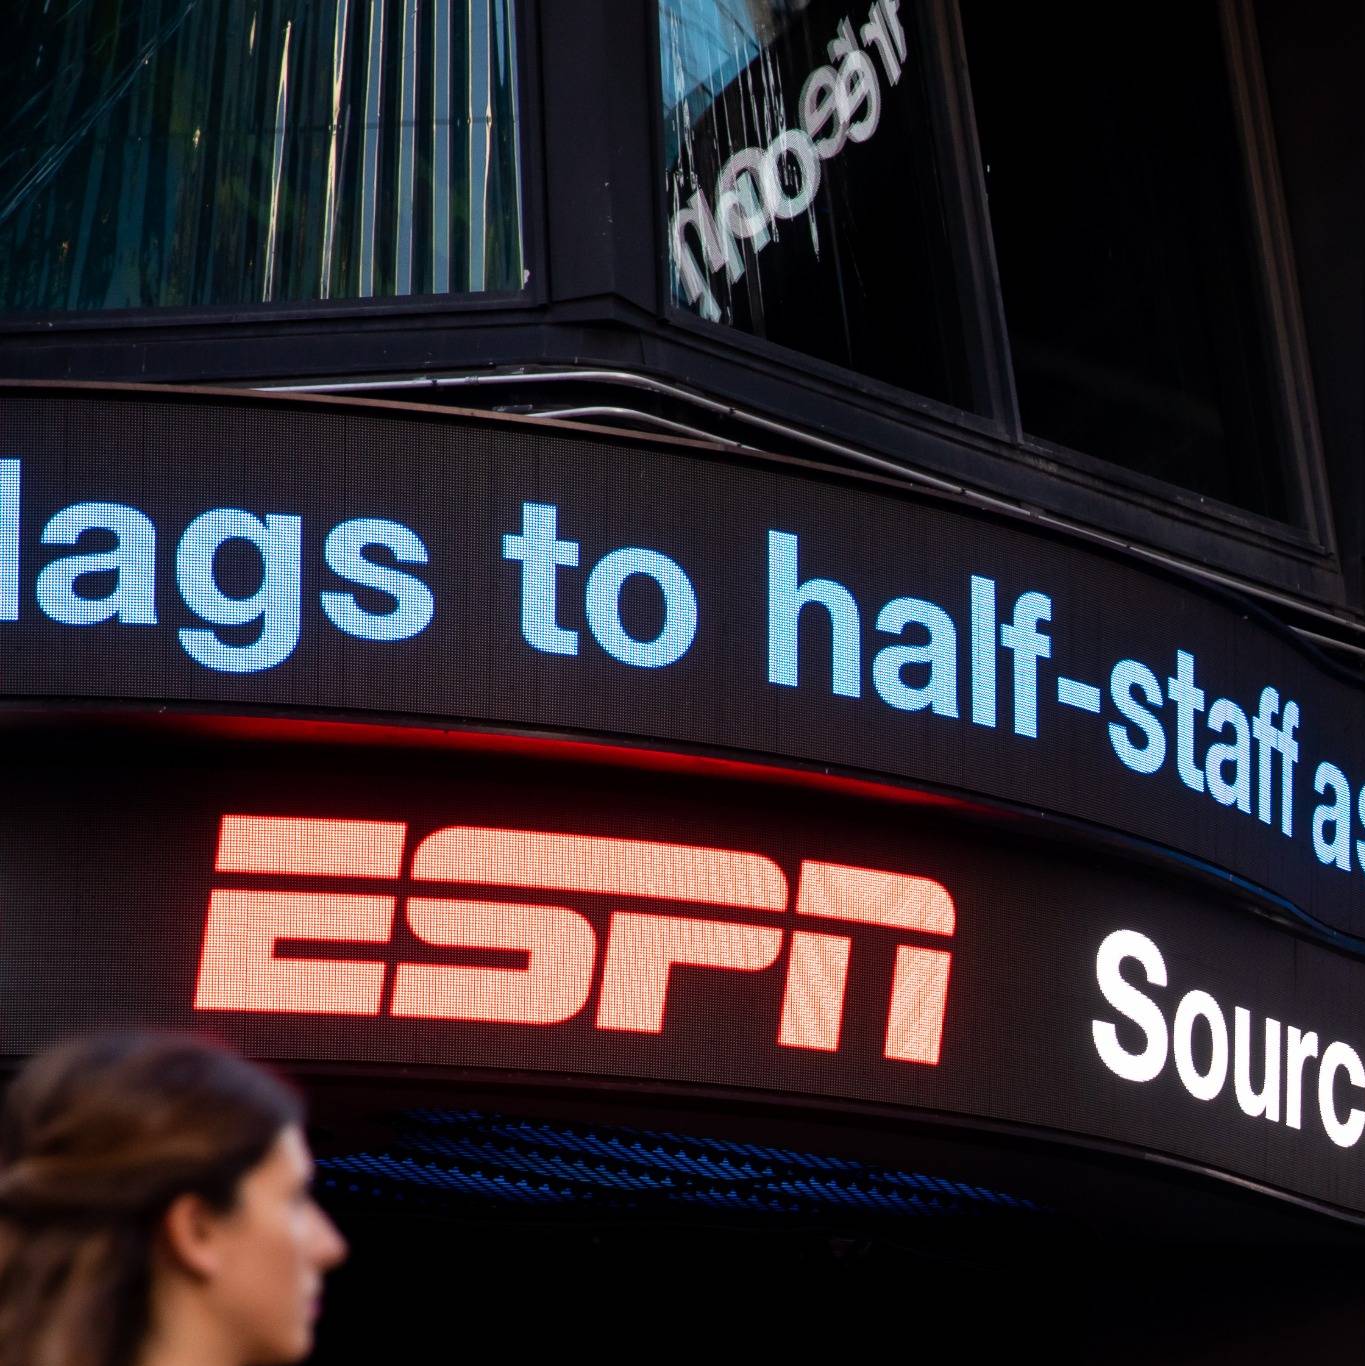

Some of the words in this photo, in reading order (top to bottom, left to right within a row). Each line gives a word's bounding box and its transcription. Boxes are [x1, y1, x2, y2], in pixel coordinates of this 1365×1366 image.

[0, 455, 440, 677] lags
[500, 500, 699, 669] to
[769, 531, 1300, 837] half-staff
[194, 814, 956, 1066] ESPN
